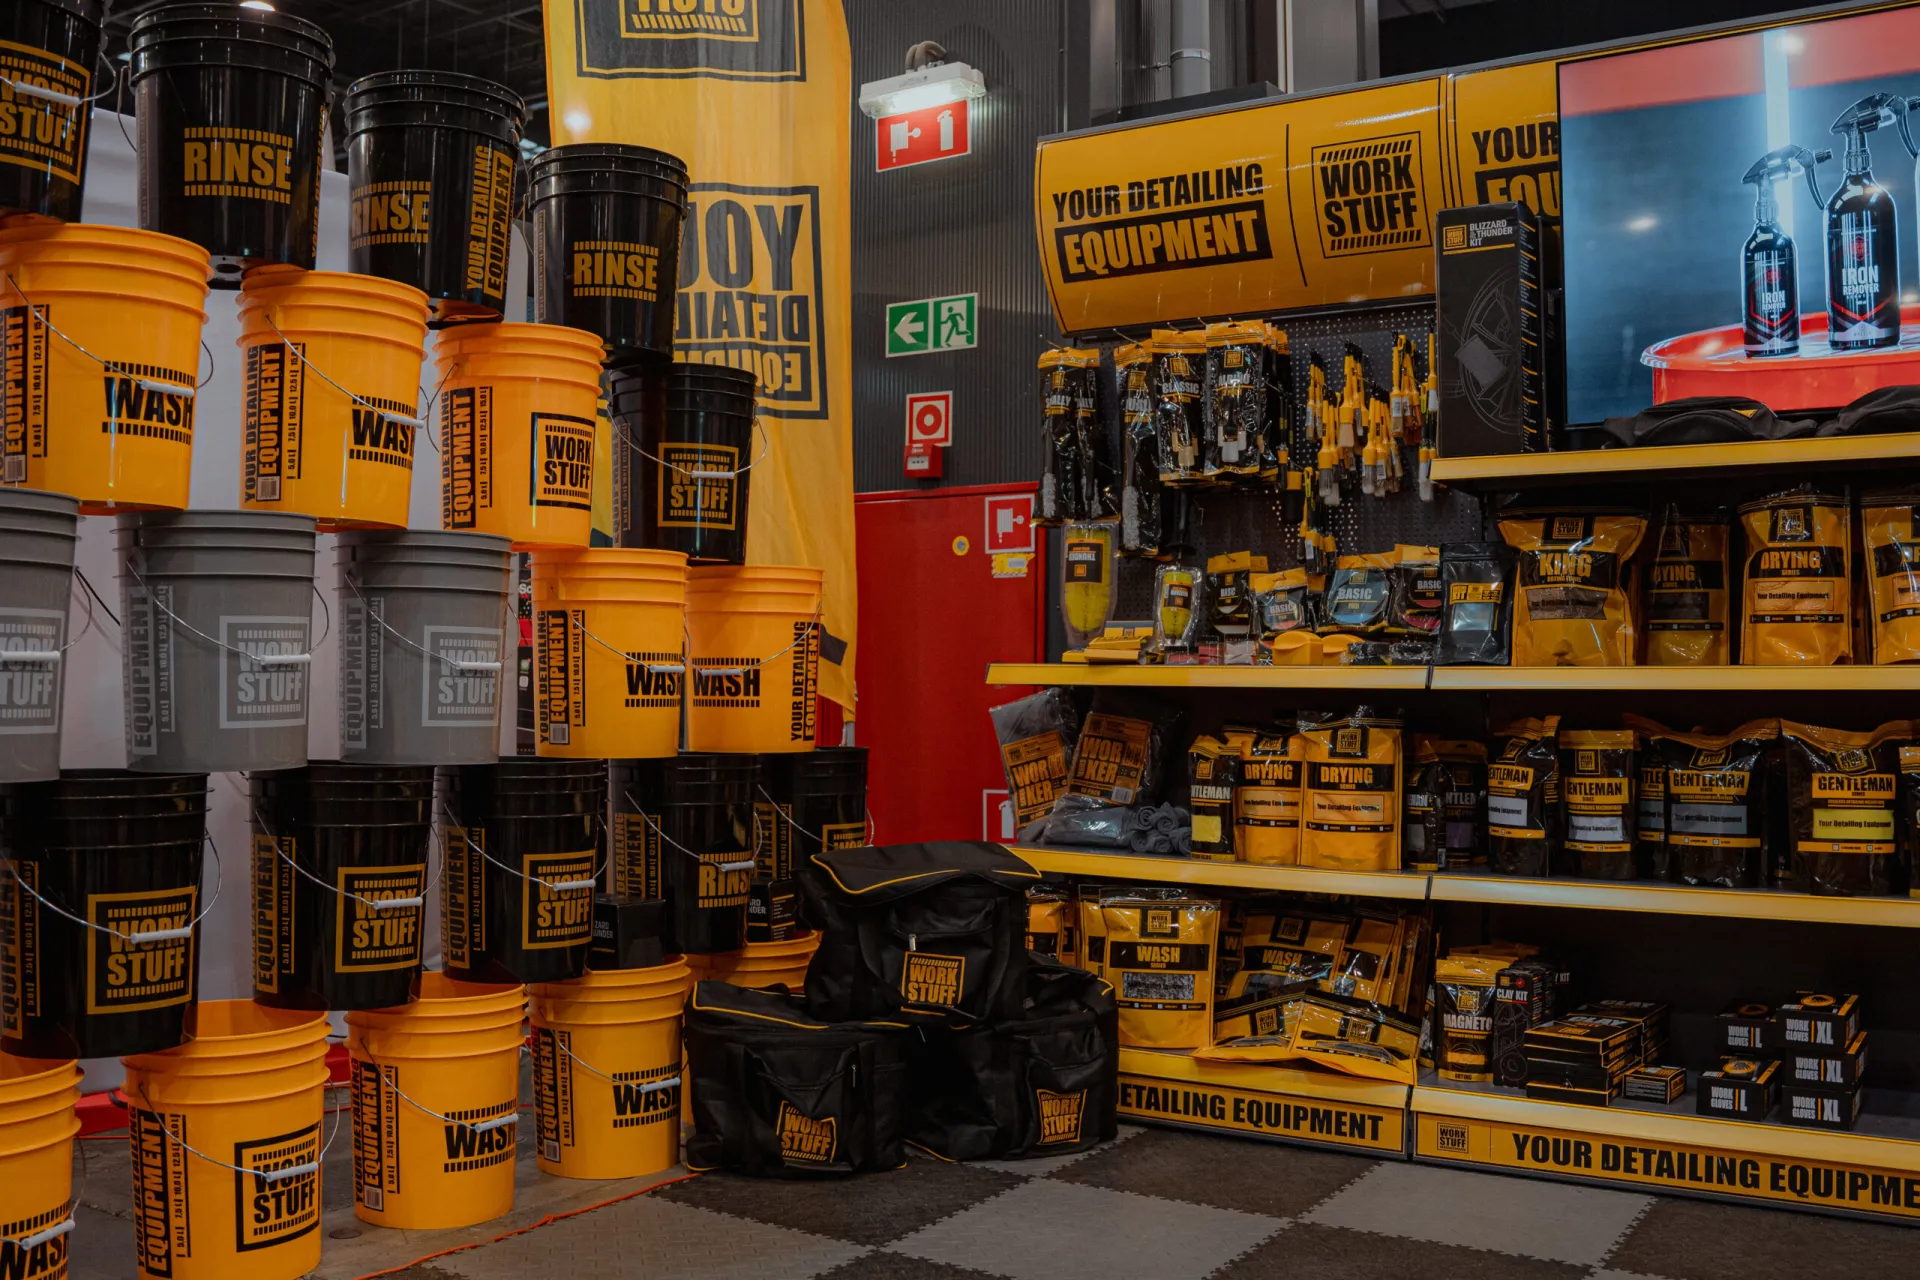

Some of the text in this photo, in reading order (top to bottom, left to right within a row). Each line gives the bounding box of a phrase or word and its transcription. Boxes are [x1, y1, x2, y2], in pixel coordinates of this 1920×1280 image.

[0, 103, 77, 153] STUFF
[1472, 121, 1559, 165] YOUR
[184, 141, 291, 190] RINSE
[1320, 154, 1415, 200] WORK
[1052, 163, 1264, 222] YOUR DETAILING
[351, 193, 429, 232] RINSE
[467, 145, 493, 290] YOUR DETAILING
[487, 156, 511, 291] EQUIPMENT
[1324, 190, 1418, 238] STUFF
[1469, 219, 1508, 231] BLIZZARD
[1476, 226, 1513, 238] THUNDER
[1062, 210, 1259, 275] EQUIPMENT
[1469, 237, 1482, 247] KIT
[574, 253, 658, 290] RINSE
[1841, 265, 1879, 285] IRON
[1761, 290, 1786, 303] IRON
[1842, 283, 1880, 295] REMOVER
[4, 312, 24, 454] EQUIPMENT
[1162, 382, 1200, 394] CLASSIC
[259, 349, 281, 476] EQUIPMENT
[352, 408, 413, 456] WAS
[453, 394, 473, 524] EQUIPMENT
[545, 434, 591, 465] WORK
[245, 450, 256, 503] YOUR
[544, 460, 591, 490] STUFF
[671, 462, 729, 487] WORK
[670, 485, 728, 510] STUFF
[1539, 553, 1592, 577] KING
[1761, 551, 1821, 570] DRYING
[1336, 587, 1373, 600] BASIC
[1417, 580, 1442, 590] BASIC
[130, 590, 153, 748] EQUIPMENT
[346, 604, 363, 742] EQUIPMENT
[537, 611, 548, 744] YOUR DETAILING
[550, 614, 566, 723] EQUIPMENT
[237, 671, 302, 703] STUFF
[438, 676, 496, 704] STUFF
[692, 668, 761, 697] WASH
[791, 621, 807, 741] YOUR DETAILING
[1244, 764, 1293, 780] DRYING
[1320, 767, 1373, 783] DRYING
[1673, 772, 1745, 788] GENTLEMAN
[1818, 775, 1893, 792] GENTLEMAN
[1818, 820, 1832, 828] Your
[1833, 820, 1862, 828] Detailing
[450, 831, 467, 964] EQUIPMENT
[258, 839, 275, 987] EQUIPMENT
[537, 899, 590, 927] STUFF
[352, 916, 416, 949] STUFF
[1136, 946, 1181, 963] WASH
[1262, 949, 1302, 968] WASH
[107, 948, 185, 986] STUFF
[909, 963, 957, 986] WORK
[907, 982, 957, 1006] STUFF
[1496, 988, 1528, 1001] CLAY KIT
[1443, 1013, 1493, 1031] MAGNETO
[1728, 1025, 1749, 1038] WORK
[1786, 1018, 1809, 1031] WORK
[1816, 1022, 1834, 1045] XL
[1728, 1036, 1749, 1047] GLOVES
[1755, 1028, 1763, 1048] L
[1786, 1030, 1809, 1042] GLOVES
[1795, 1056, 1819, 1069] WORK
[1826, 1060, 1843, 1083] XL
[541, 1033, 557, 1140] EQUIPMENT
[1795, 1069, 1818, 1081] GLOVES
[1711, 1086, 1734, 1099] WORK
[1711, 1098, 1733, 1110] GLOVES
[1740, 1089, 1748, 1112] L
[1792, 1096, 1816, 1109] WORK
[1041, 1098, 1080, 1117] WORK
[1232, 1097, 1384, 1141] EQUIPMENT
[1792, 1108, 1815, 1120] GLOVES
[1823, 1098, 1841, 1122] XL
[362, 1068, 381, 1186] EQUIPMENT
[784, 1109, 832, 1134] WORK
[1043, 1114, 1079, 1135] STUFF
[1439, 1125, 1466, 1139] WORK
[781, 1131, 832, 1155] STUFF
[1439, 1136, 1467, 1150] STUFF
[1512, 1132, 1920, 1209] YOUR DETAILING EQUIPME
[140, 1115, 169, 1272] EQUIPMENT
[253, 1178, 316, 1224] STUFF
